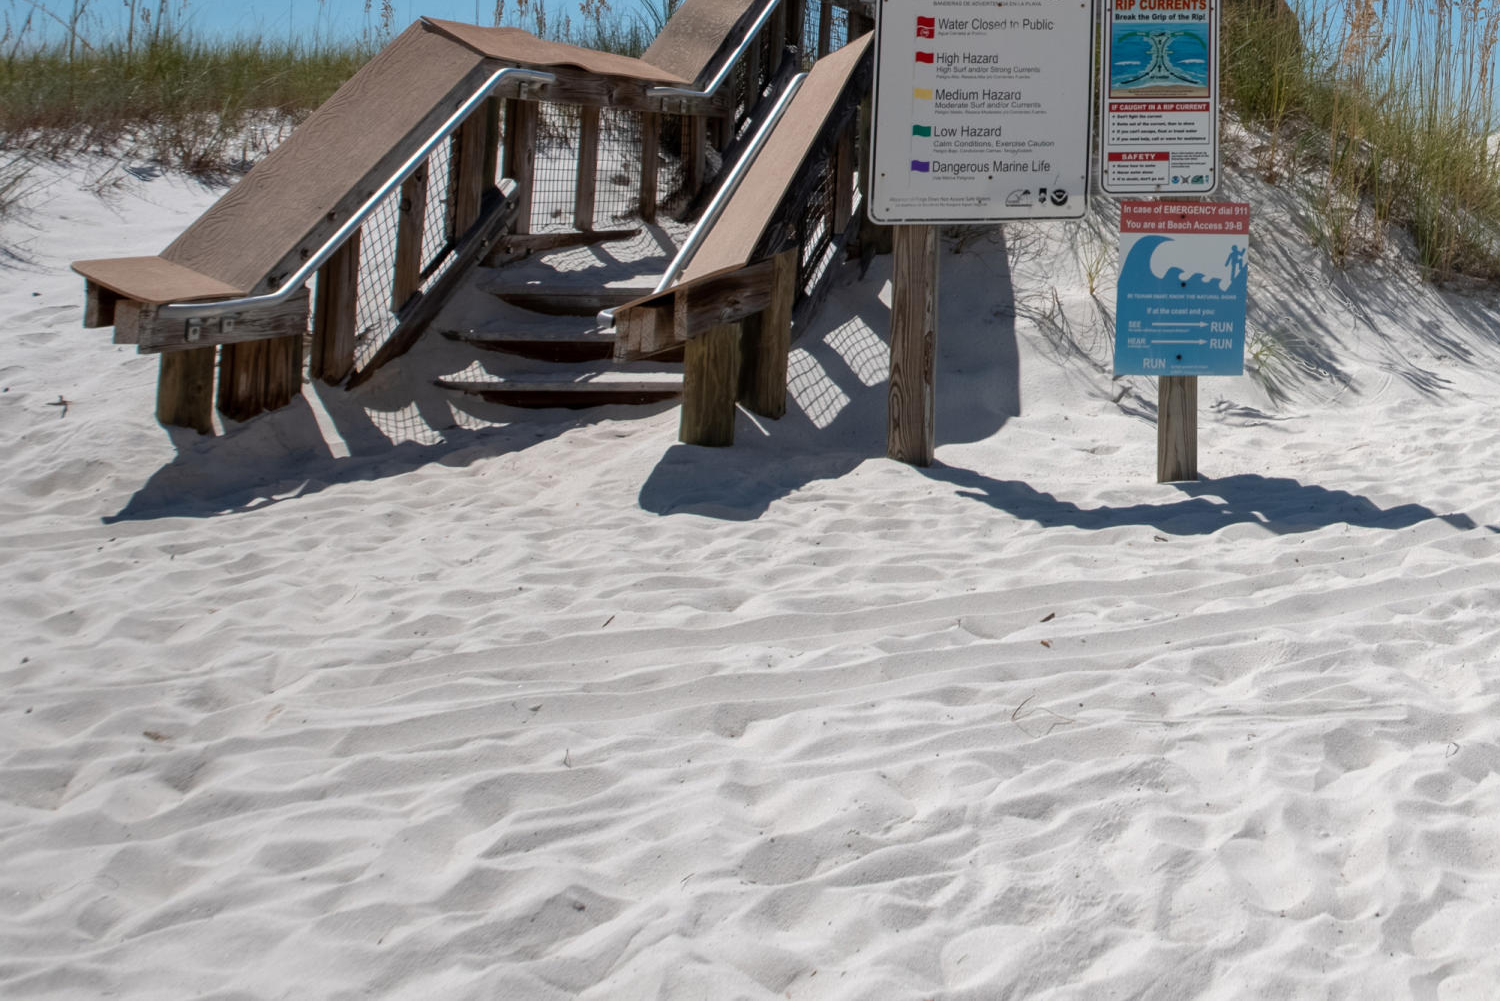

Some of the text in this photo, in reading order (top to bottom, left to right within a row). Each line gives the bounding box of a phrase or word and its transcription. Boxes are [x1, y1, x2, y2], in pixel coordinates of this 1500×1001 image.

[938, 18, 968, 30] Water
[971, 18, 1007, 30] Closed
[1023, 18, 1054, 30] Public
[936, 52, 999, 66] High Hazard
[935, 89, 1022, 100] Medium Hazard
[934, 126, 1002, 137] Low Hazard
[954, 140, 994, 148] Conditions,
[932, 160, 1050, 175] Dangerous Marine Life
[1124, 205, 1131, 214] In
[1155, 205, 1162, 214] of
[1164, 205, 1216, 215] EMERGENCY
[1218, 206, 1232, 215] dial
[1234, 206, 1248, 215] 911
[1126, 220, 1141, 229] You
[1158, 221, 1165, 229] at
[1168, 220, 1192, 229] Beach
[1194, 221, 1223, 230] Access
[1224, 221, 1242, 230] 39-B
[1211, 322, 1233, 333] RUN
[1209, 339, 1232, 349] RUN
[1143, 358, 1166, 368] RUN
